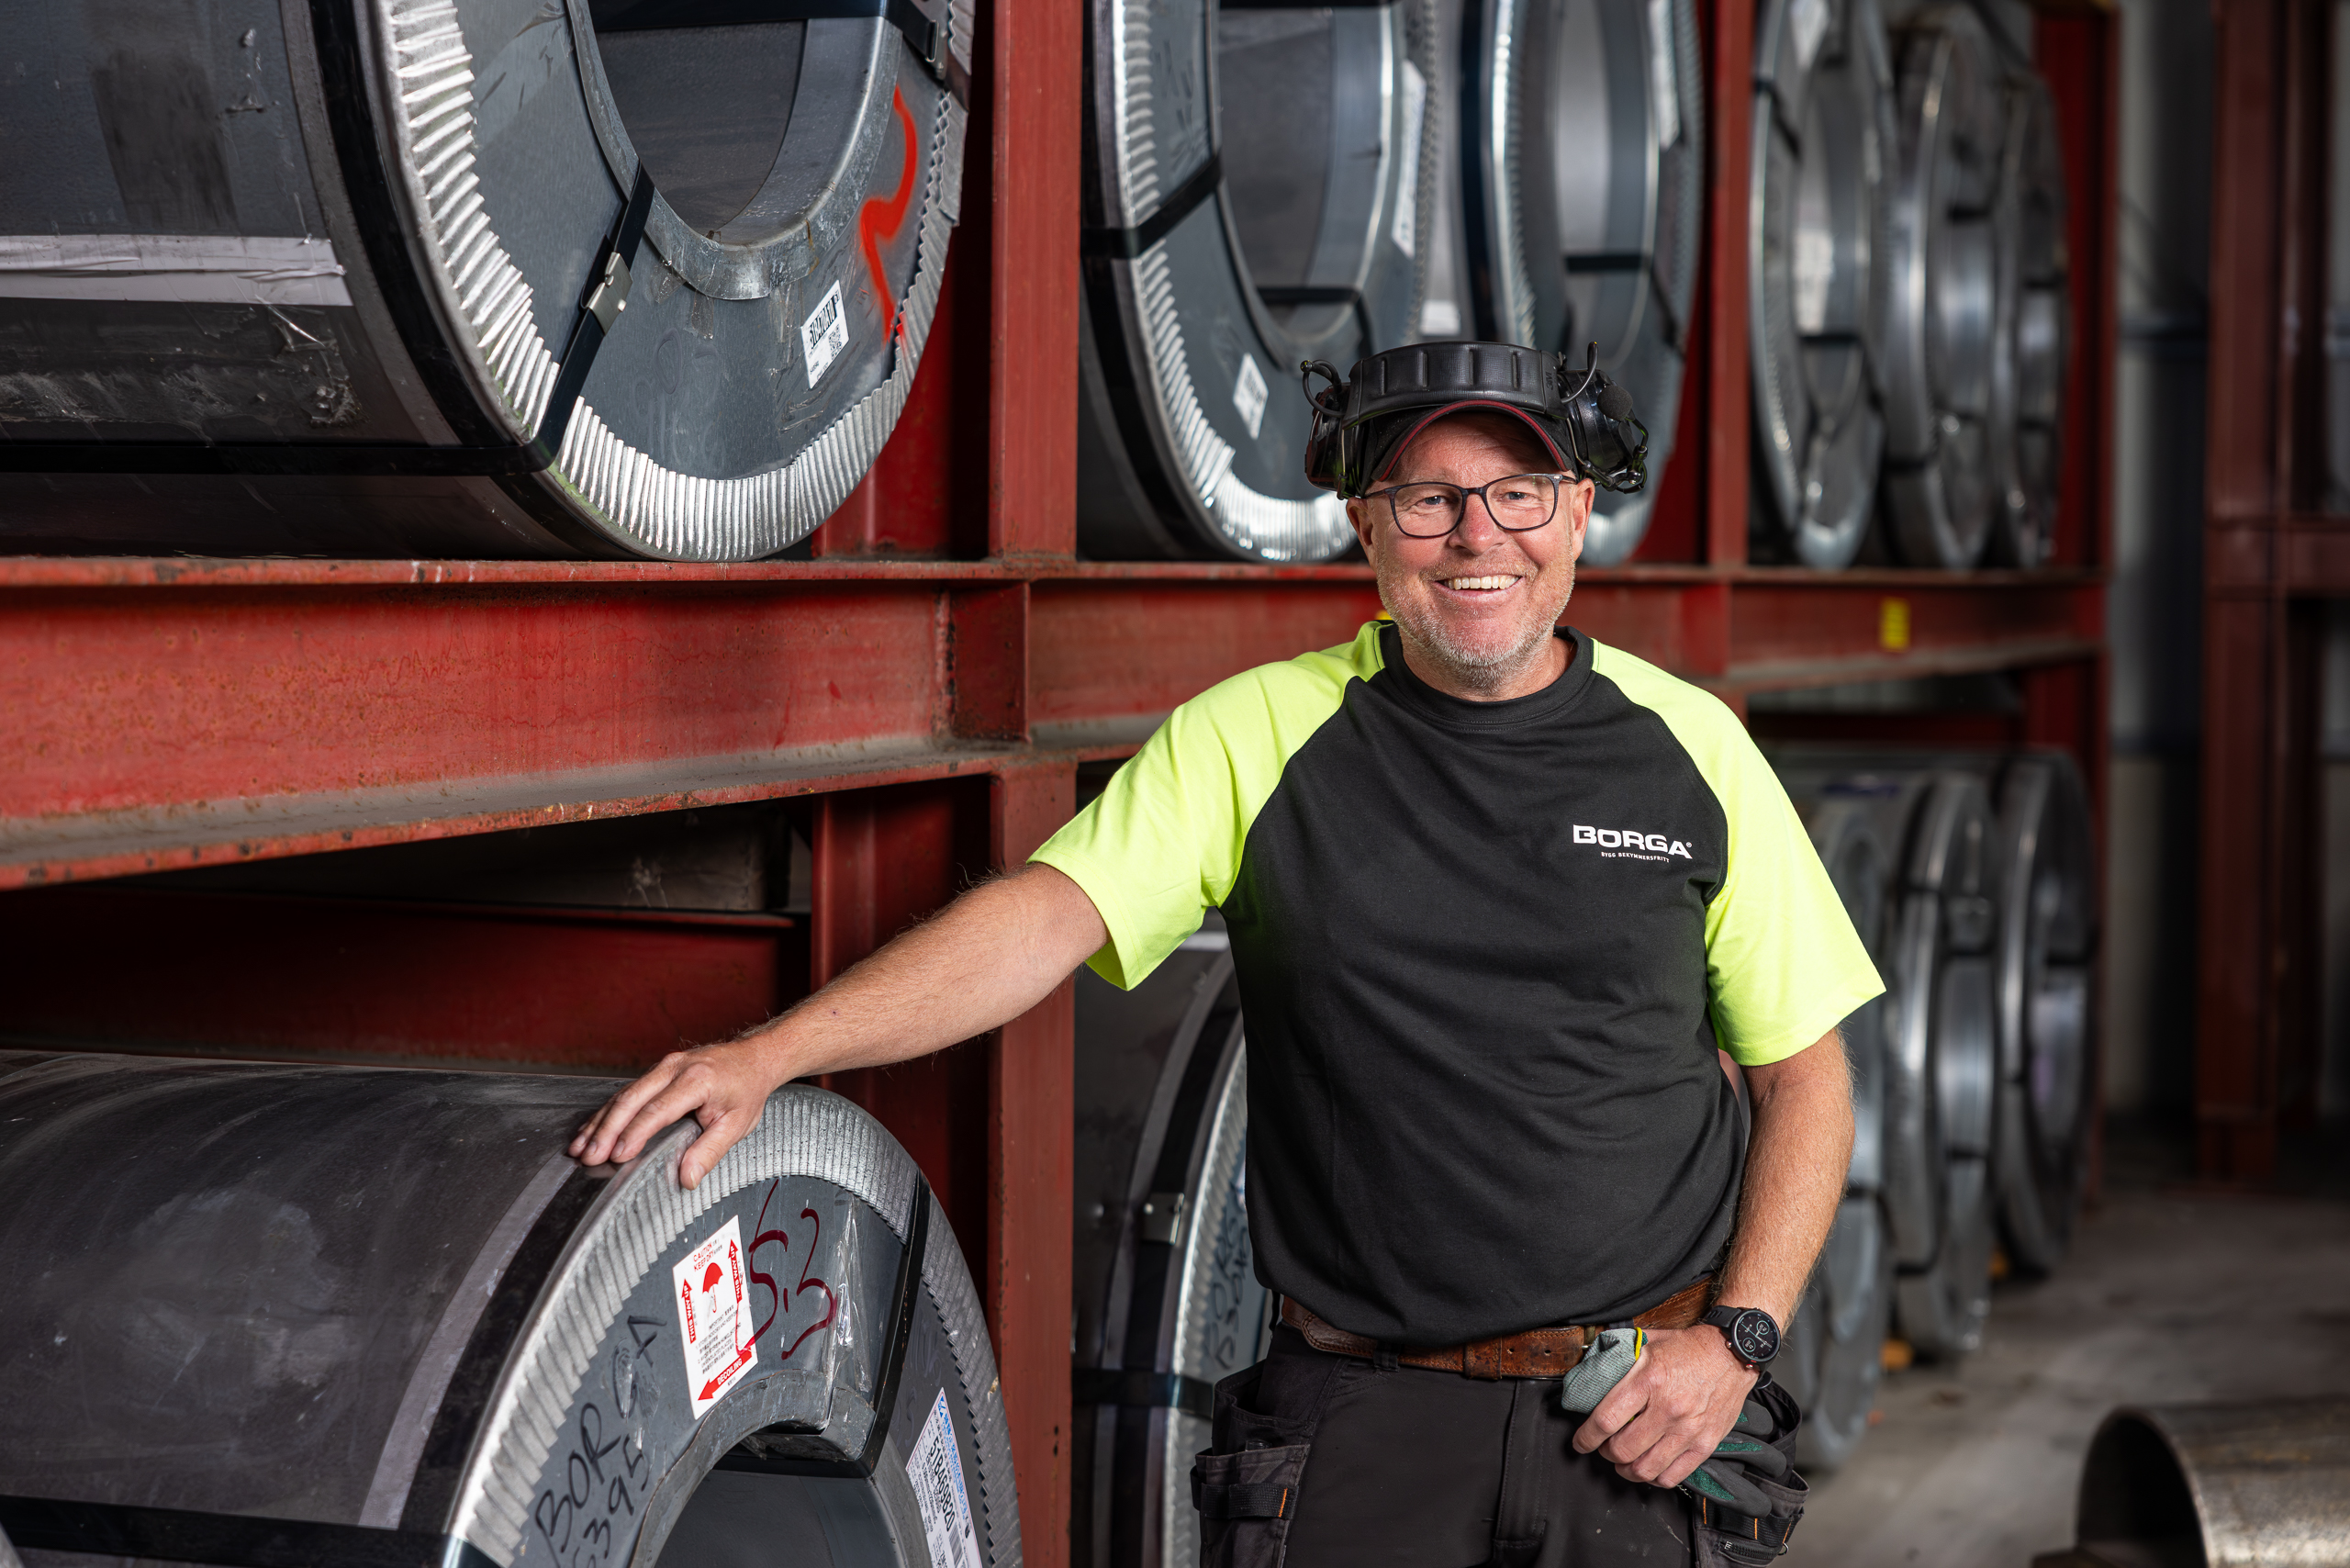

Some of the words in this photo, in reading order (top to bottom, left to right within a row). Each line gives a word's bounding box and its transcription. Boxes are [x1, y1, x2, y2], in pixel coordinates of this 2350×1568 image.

[1618, 852, 1670, 863] BEKYMMERSFRITT
[730, 1244, 736, 1259] UP
[693, 1257, 706, 1272] KEEP
[684, 1284, 689, 1298] UP
[717, 1358, 743, 1385] DECOILING
[930, 1436, 955, 1532] 51B469B20
